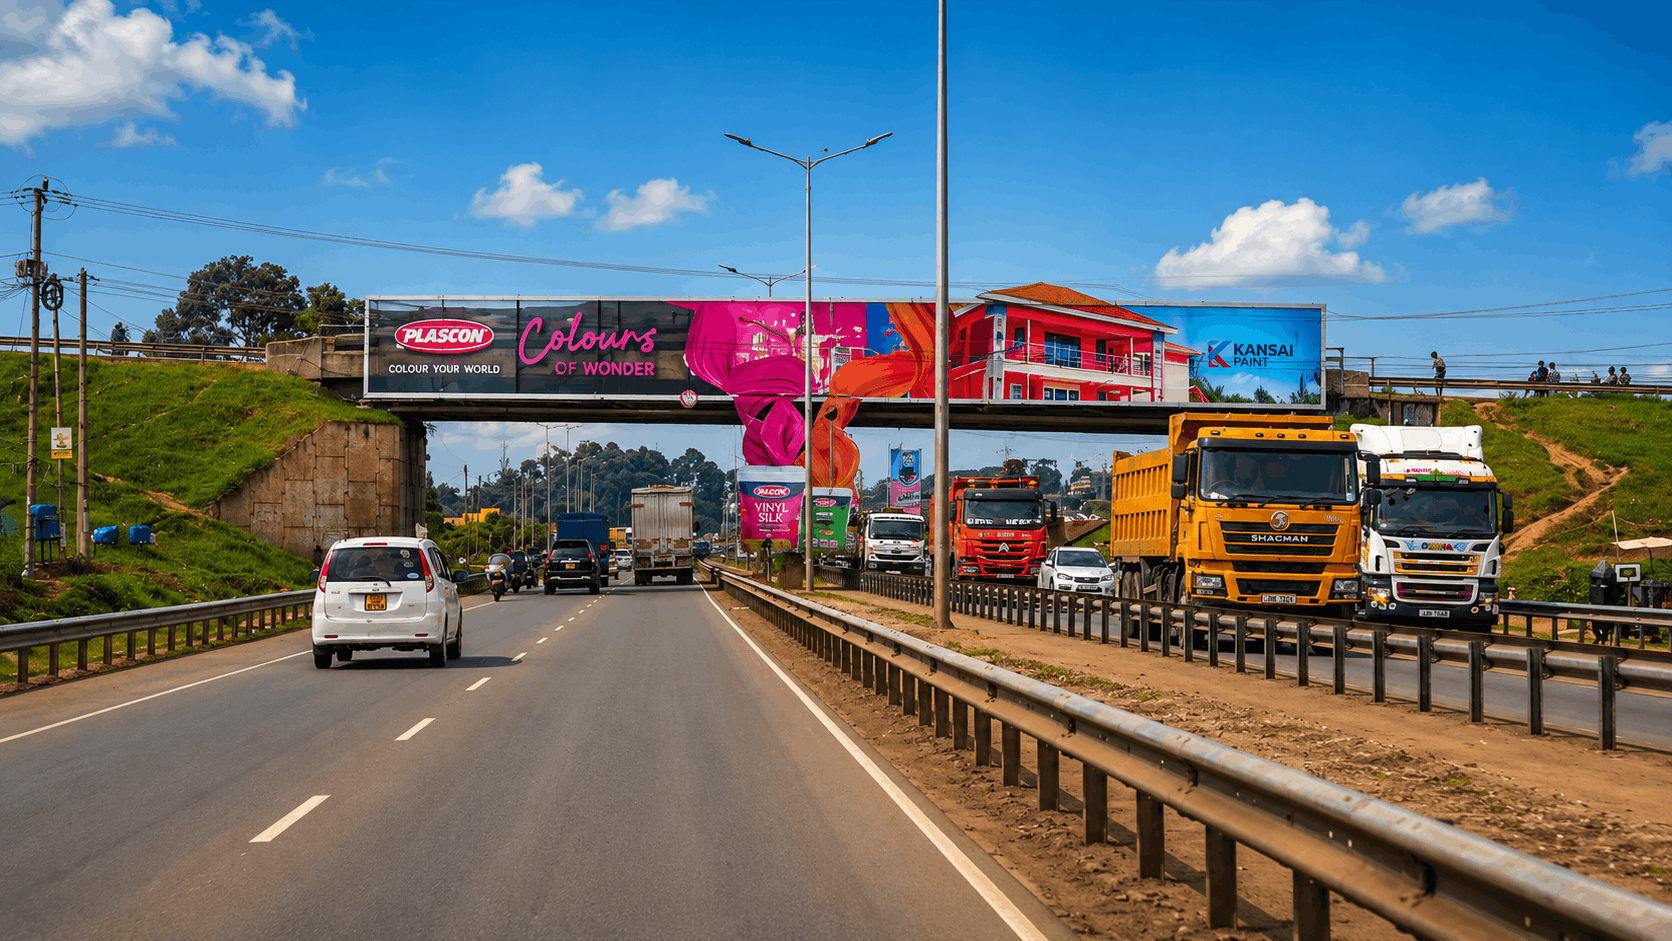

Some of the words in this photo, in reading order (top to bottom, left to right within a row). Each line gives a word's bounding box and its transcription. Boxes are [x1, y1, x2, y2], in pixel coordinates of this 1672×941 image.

[402, 328, 488, 343] PLASCON
[518, 311, 657, 365] Colours
[1233, 343, 1294, 357] KANSAI
[1233, 356, 1269, 367] PAINT
[388, 364, 429, 374] COLOUR
[432, 364, 460, 374] YOUR
[464, 364, 500, 374] WORLD
[555, 361, 577, 375] OF
[582, 361, 655, 376] WONDER
[755, 502, 789, 513] VINYL
[758, 512, 783, 523] SILK
[1251, 534, 1309, 543] SHACMAN
